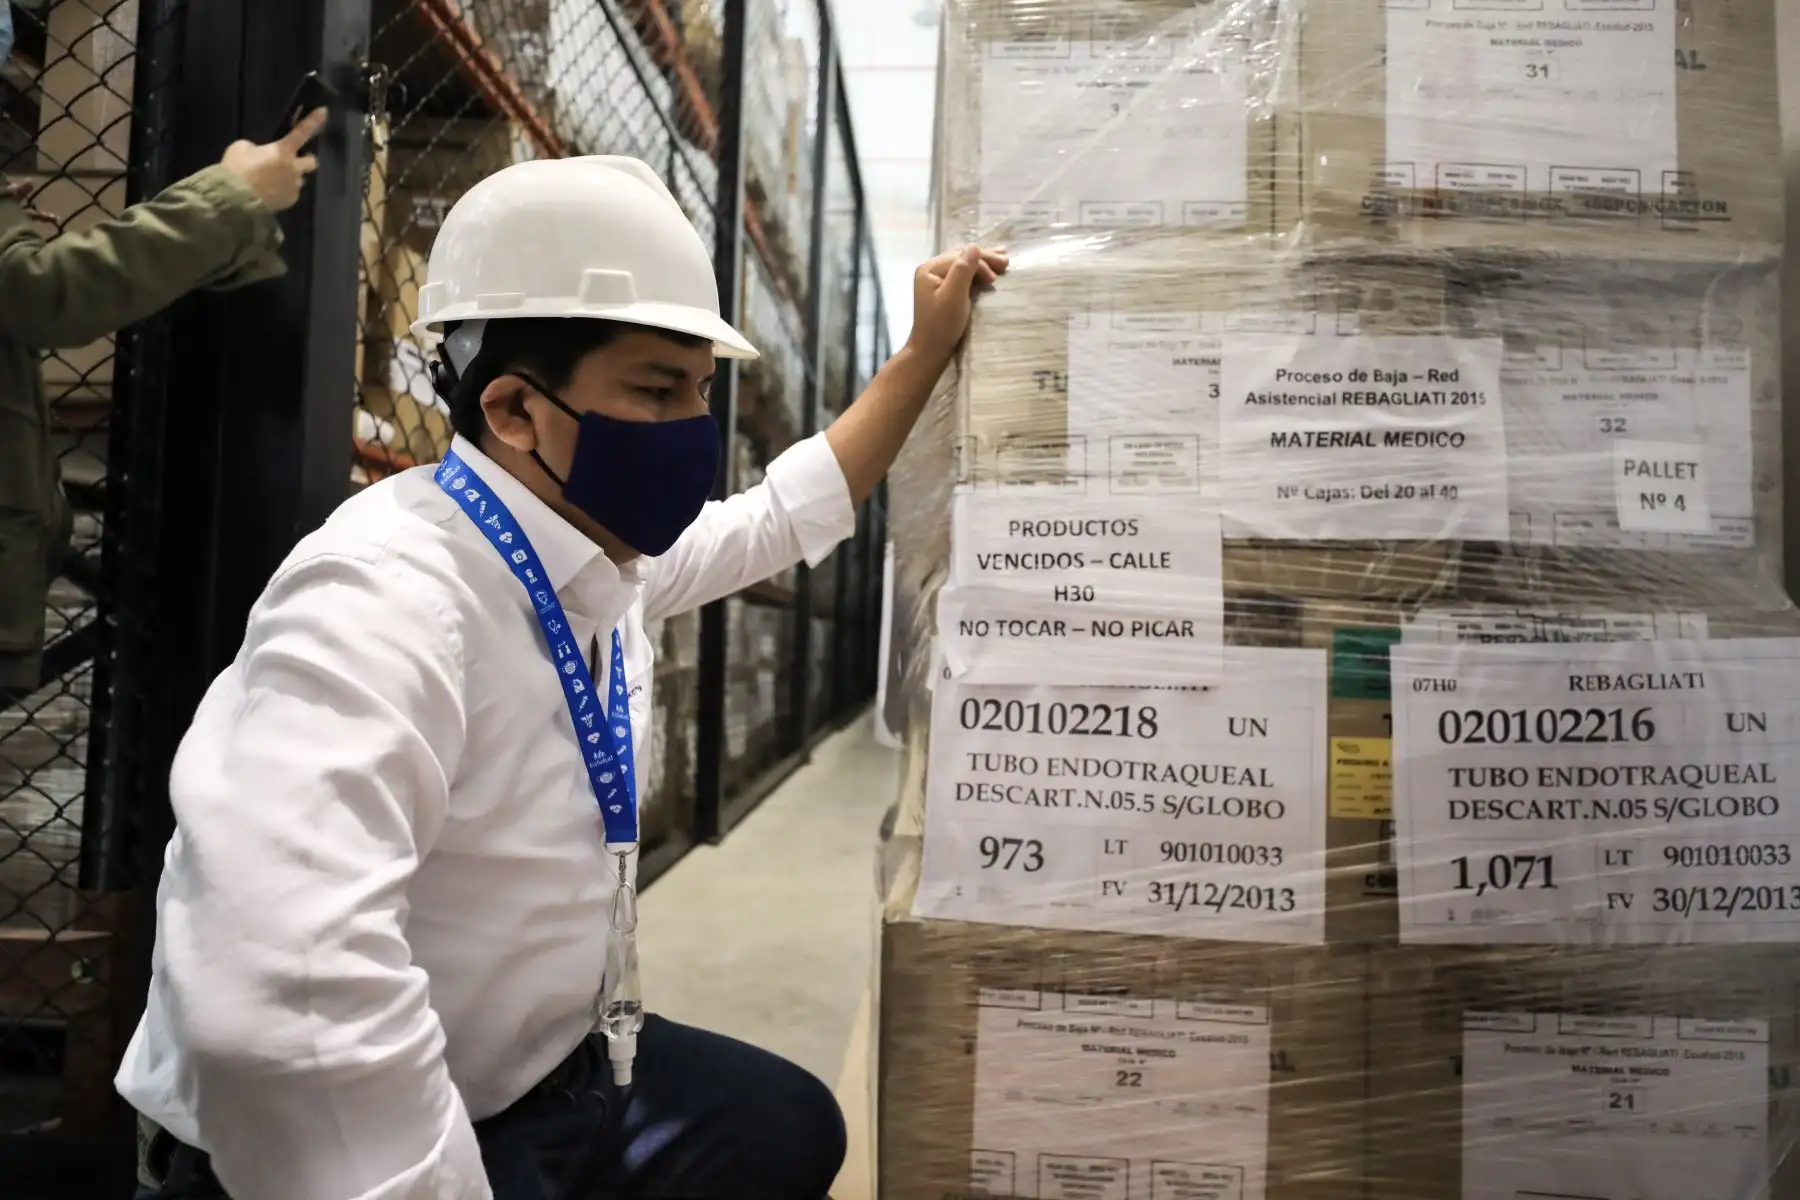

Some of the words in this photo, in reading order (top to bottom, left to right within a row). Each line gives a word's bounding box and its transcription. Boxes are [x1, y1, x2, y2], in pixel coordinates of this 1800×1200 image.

[1526, 63, 1549, 80] 31
[1276, 368, 1343, 384] Proceso
[1348, 368, 1368, 383] de
[1374, 369, 1408, 385] Baja
[1428, 368, 1459, 383] Red
[1245, 391, 1337, 406] Asistencial
[1341, 391, 1446, 407] REBAGLIATI
[1450, 391, 1486, 407] 2015
[1600, 417, 1628, 434] 32
[1270, 431, 1377, 449] MATERIAL
[1383, 431, 1466, 449] MEDICO
[1624, 459, 1699, 480] PALLET
[1304, 484, 1356, 503] Cajas:
[1360, 483, 1390, 500] Del
[1394, 484, 1415, 500] 20
[1419, 484, 1435, 500] al
[1674, 494, 1686, 512] 4
[1008, 518, 1139, 538] PRODUCTOS
[977, 551, 1085, 570] VENCIDOS
[1110, 551, 1171, 569] CALLE
[1054, 584, 1095, 603] H30
[960, 620, 989, 638] NO
[998, 620, 1067, 637] TOCAR
[1091, 620, 1124, 637] NO
[1131, 620, 1195, 638] PICAR
[1568, 672, 1706, 692] REBAGLIATI
[959, 697, 1159, 740] 020102218
[1228, 716, 1269, 738] UN
[1437, 706, 1656, 745] 020102216
[1726, 711, 1767, 733] UN
[966, 751, 1039, 776] TUBO
[1046, 756, 1275, 789] ENDOTRAQUEAL
[1448, 766, 1529, 788] TUBO
[1537, 762, 1777, 790] ENDOTRAQUEAL
[954, 782, 1156, 814] DESCART.N.05.5
[1162, 794, 1286, 821] S/GLOBO
[1448, 797, 1648, 821] DESCART.N.05
[1653, 795, 1780, 823] S/GLOBO
[979, 835, 1046, 873] 973
[1103, 838, 1129, 856] LT
[1160, 839, 1284, 868] 901010033
[1450, 854, 1559, 897] 1,071
[1604, 848, 1633, 867] LT
[1663, 844, 1791, 868] 901010033
[1101, 879, 1128, 897] FV
[1147, 879, 1296, 913] 31/12/2013
[1606, 892, 1635, 910] FV
[1652, 885, 1800, 918] 30/12/2013
[1115, 1070, 1142, 1088] 22
[1608, 1092, 1635, 1110] 21
